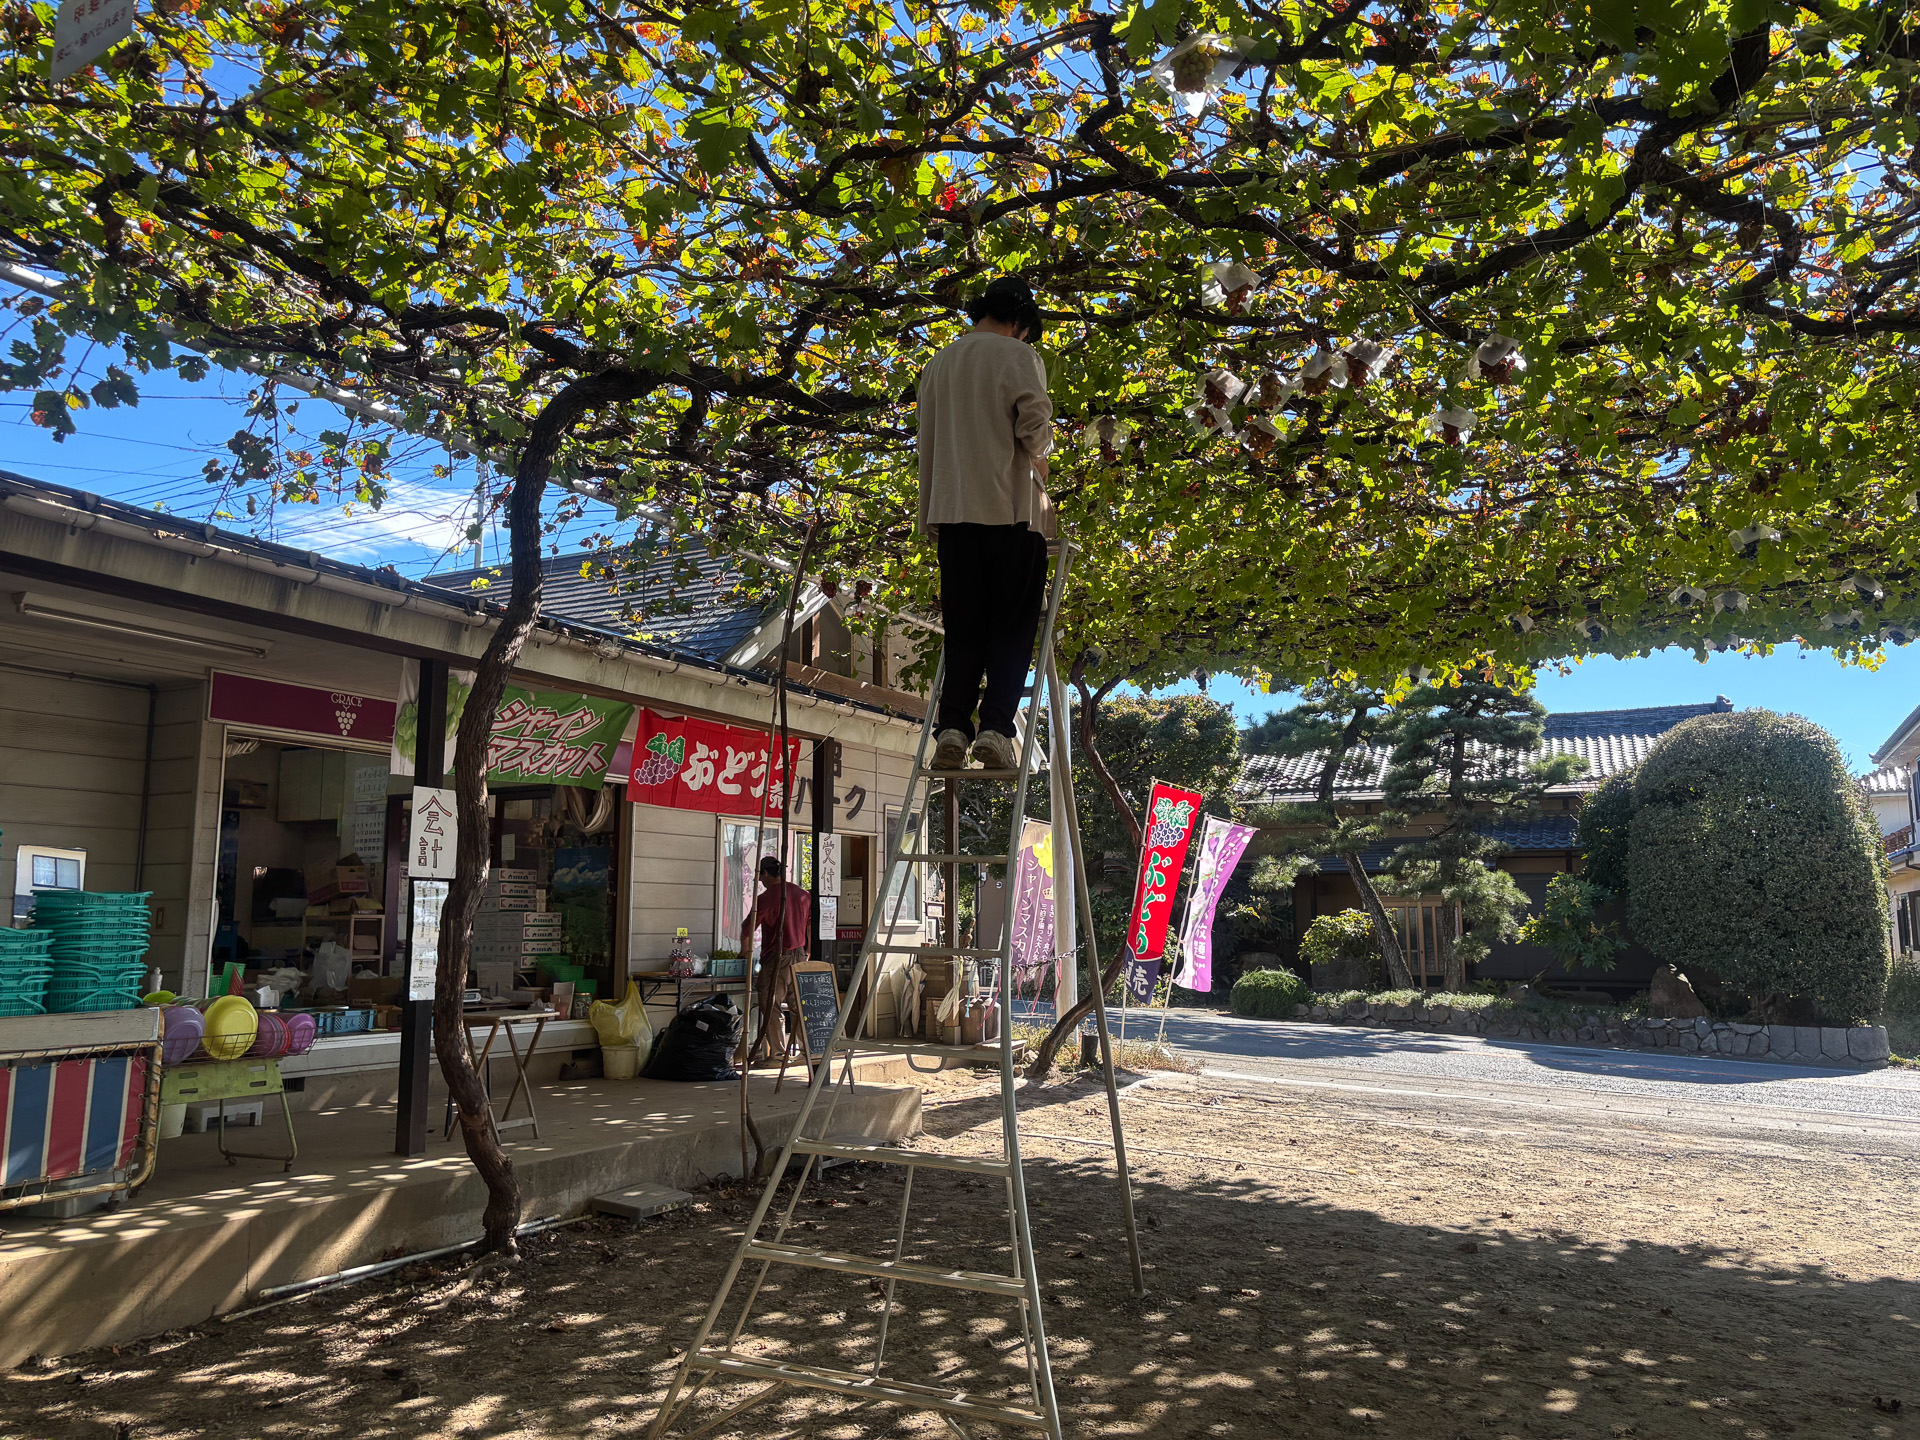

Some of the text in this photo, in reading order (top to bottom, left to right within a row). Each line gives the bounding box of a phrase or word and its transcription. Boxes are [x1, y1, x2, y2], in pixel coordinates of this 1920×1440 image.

[331, 693, 363, 708] GRACE
[491, 698, 605, 741] シャイン
[488, 734, 608, 778] マスカット
[681, 741, 768, 798] ぶどう
[418, 795, 452, 868] 会計
[821, 836, 836, 891] 受付
[1015, 859, 1039, 966] シャインマスカッ
[1135, 851, 1172, 954] ぶどう
[841, 931, 862, 939] KIRIN
